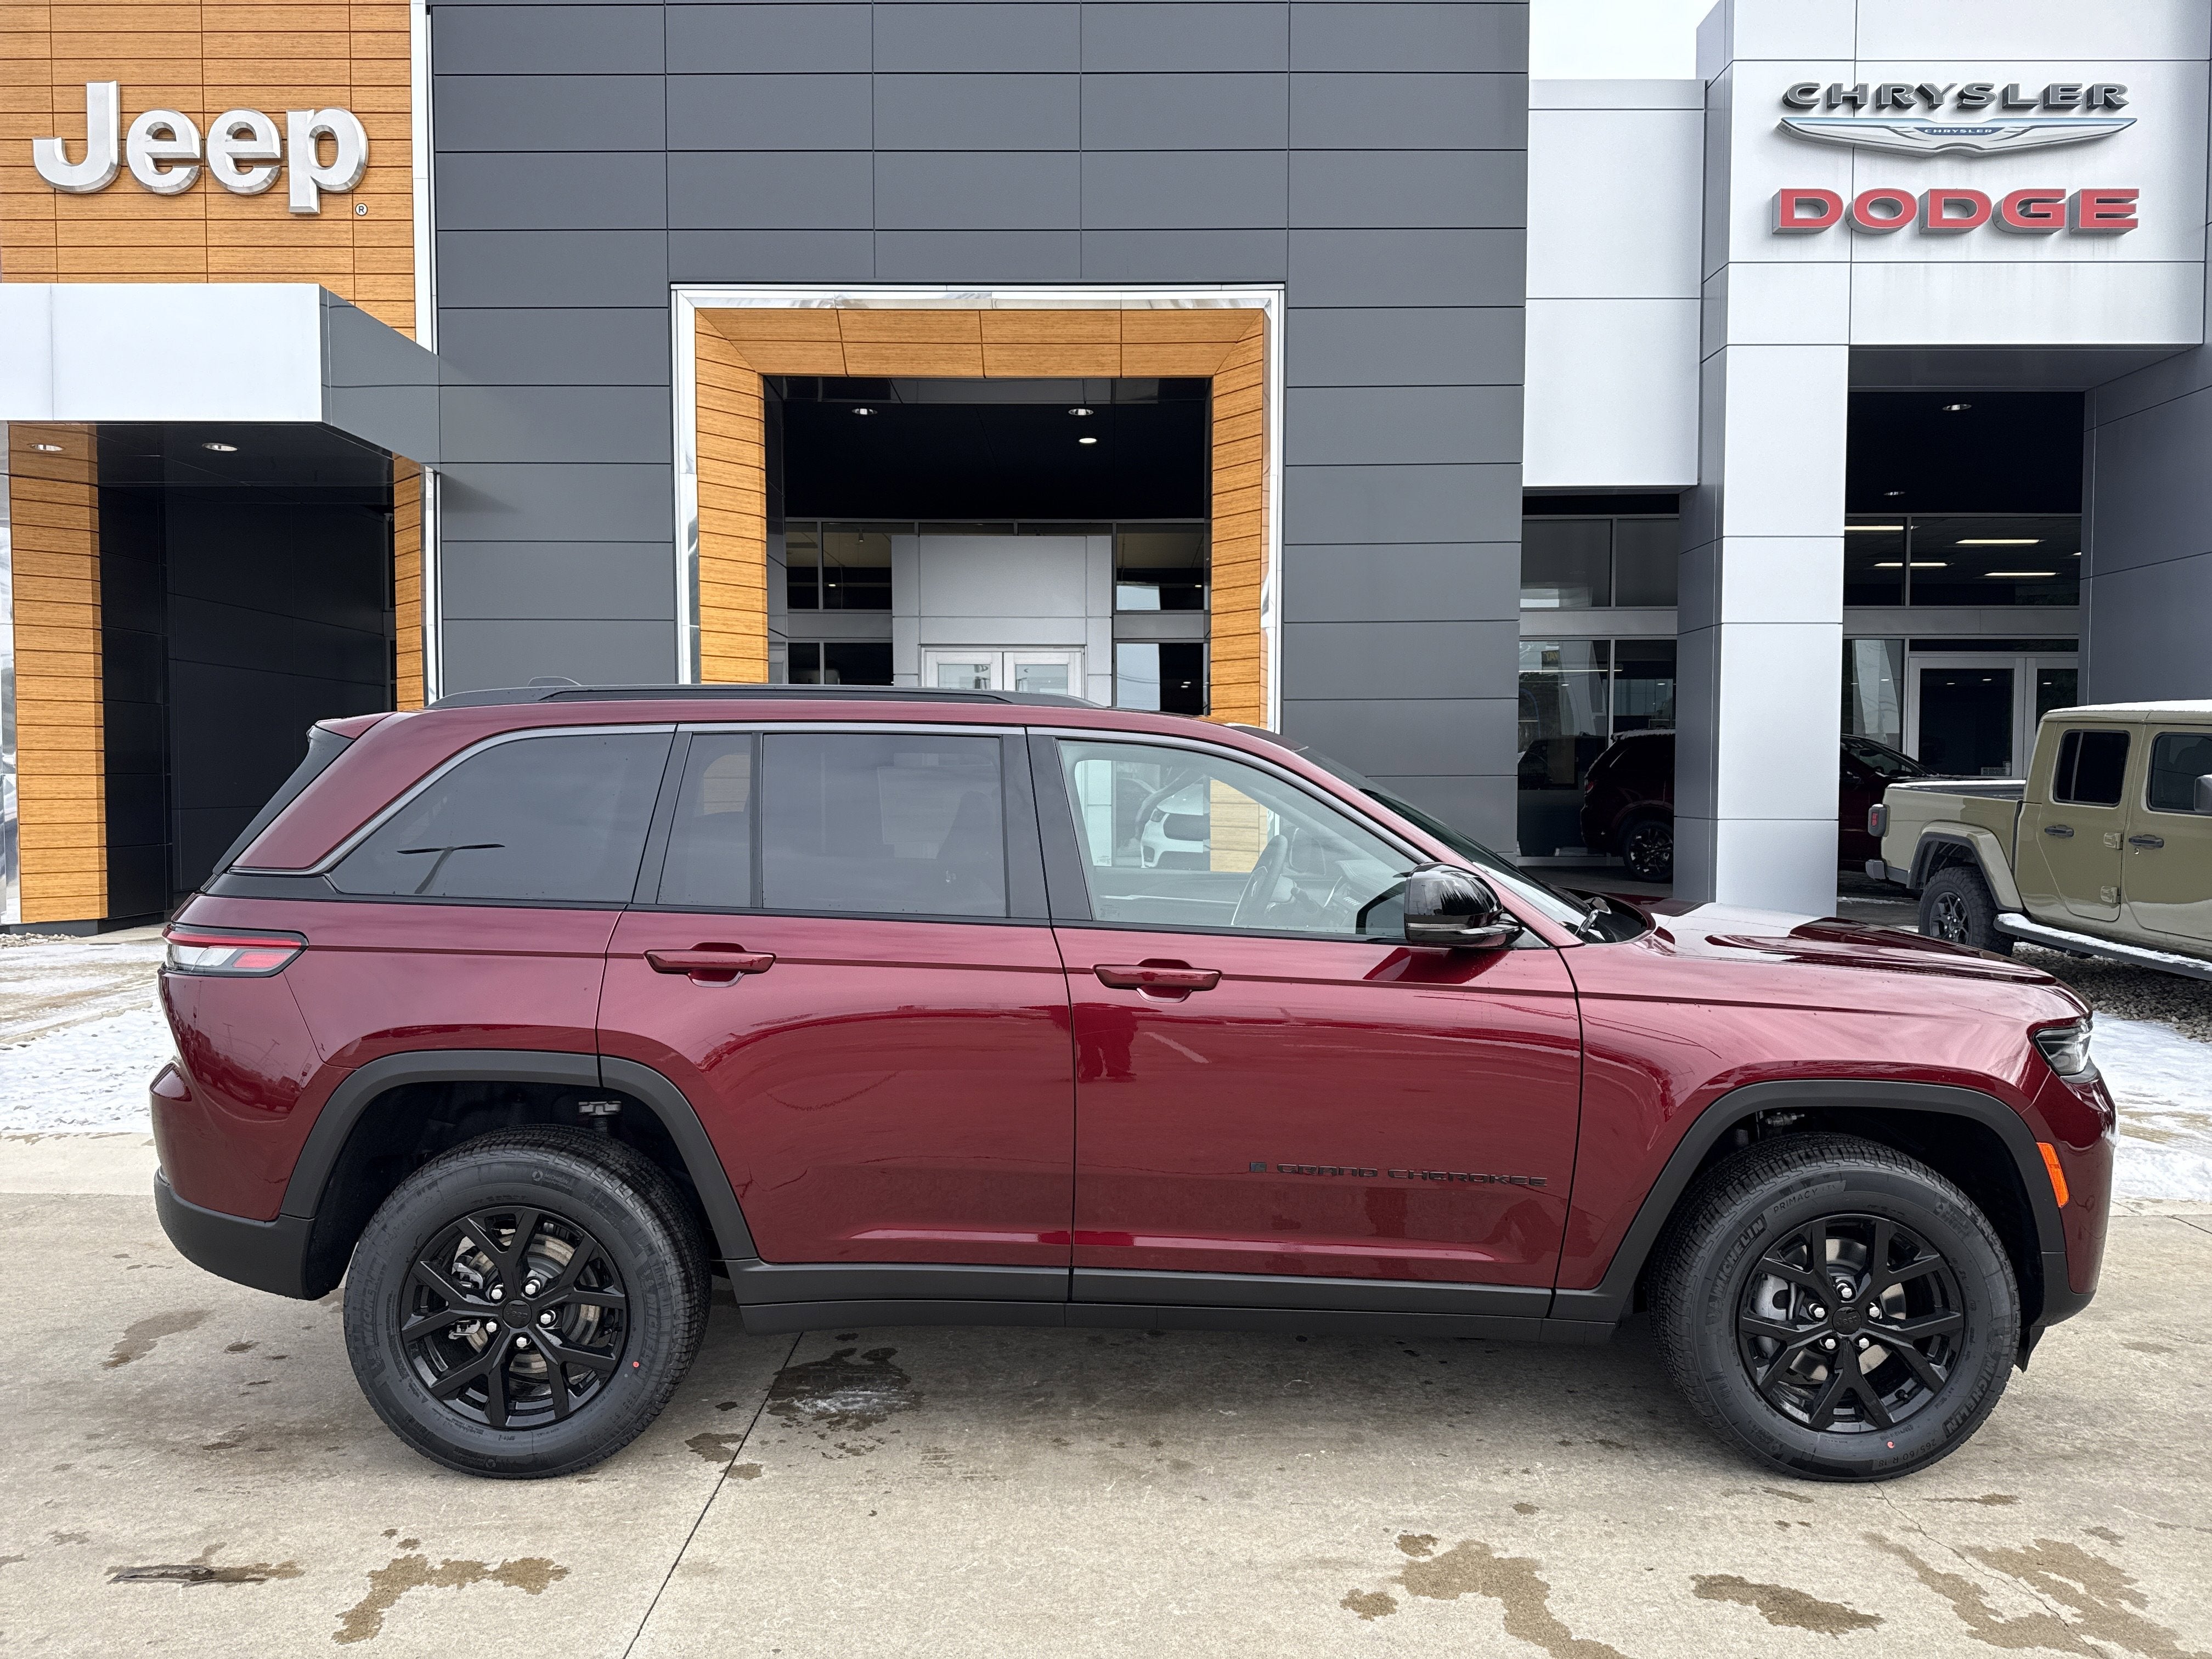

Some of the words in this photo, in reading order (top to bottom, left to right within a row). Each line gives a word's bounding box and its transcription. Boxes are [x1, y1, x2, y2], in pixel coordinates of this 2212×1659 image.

[1782, 82, 2129, 109] CHRYSLER
[32, 80, 369, 215] Jeep
[1773, 188, 2139, 233] DODGE
[1277, 1163, 1378, 1177] GRAND
[1387, 1169, 1548, 1187] CHEROKEE
[1773, 1187, 1818, 1214] PRIMACY
[1711, 1218, 1765, 1298] MICHELIN
[634, 1294, 660, 1387] MICHELIN
[1945, 1357, 1997, 1434] MICHELIN
[1903, 1438, 1937, 1460] 265/60
